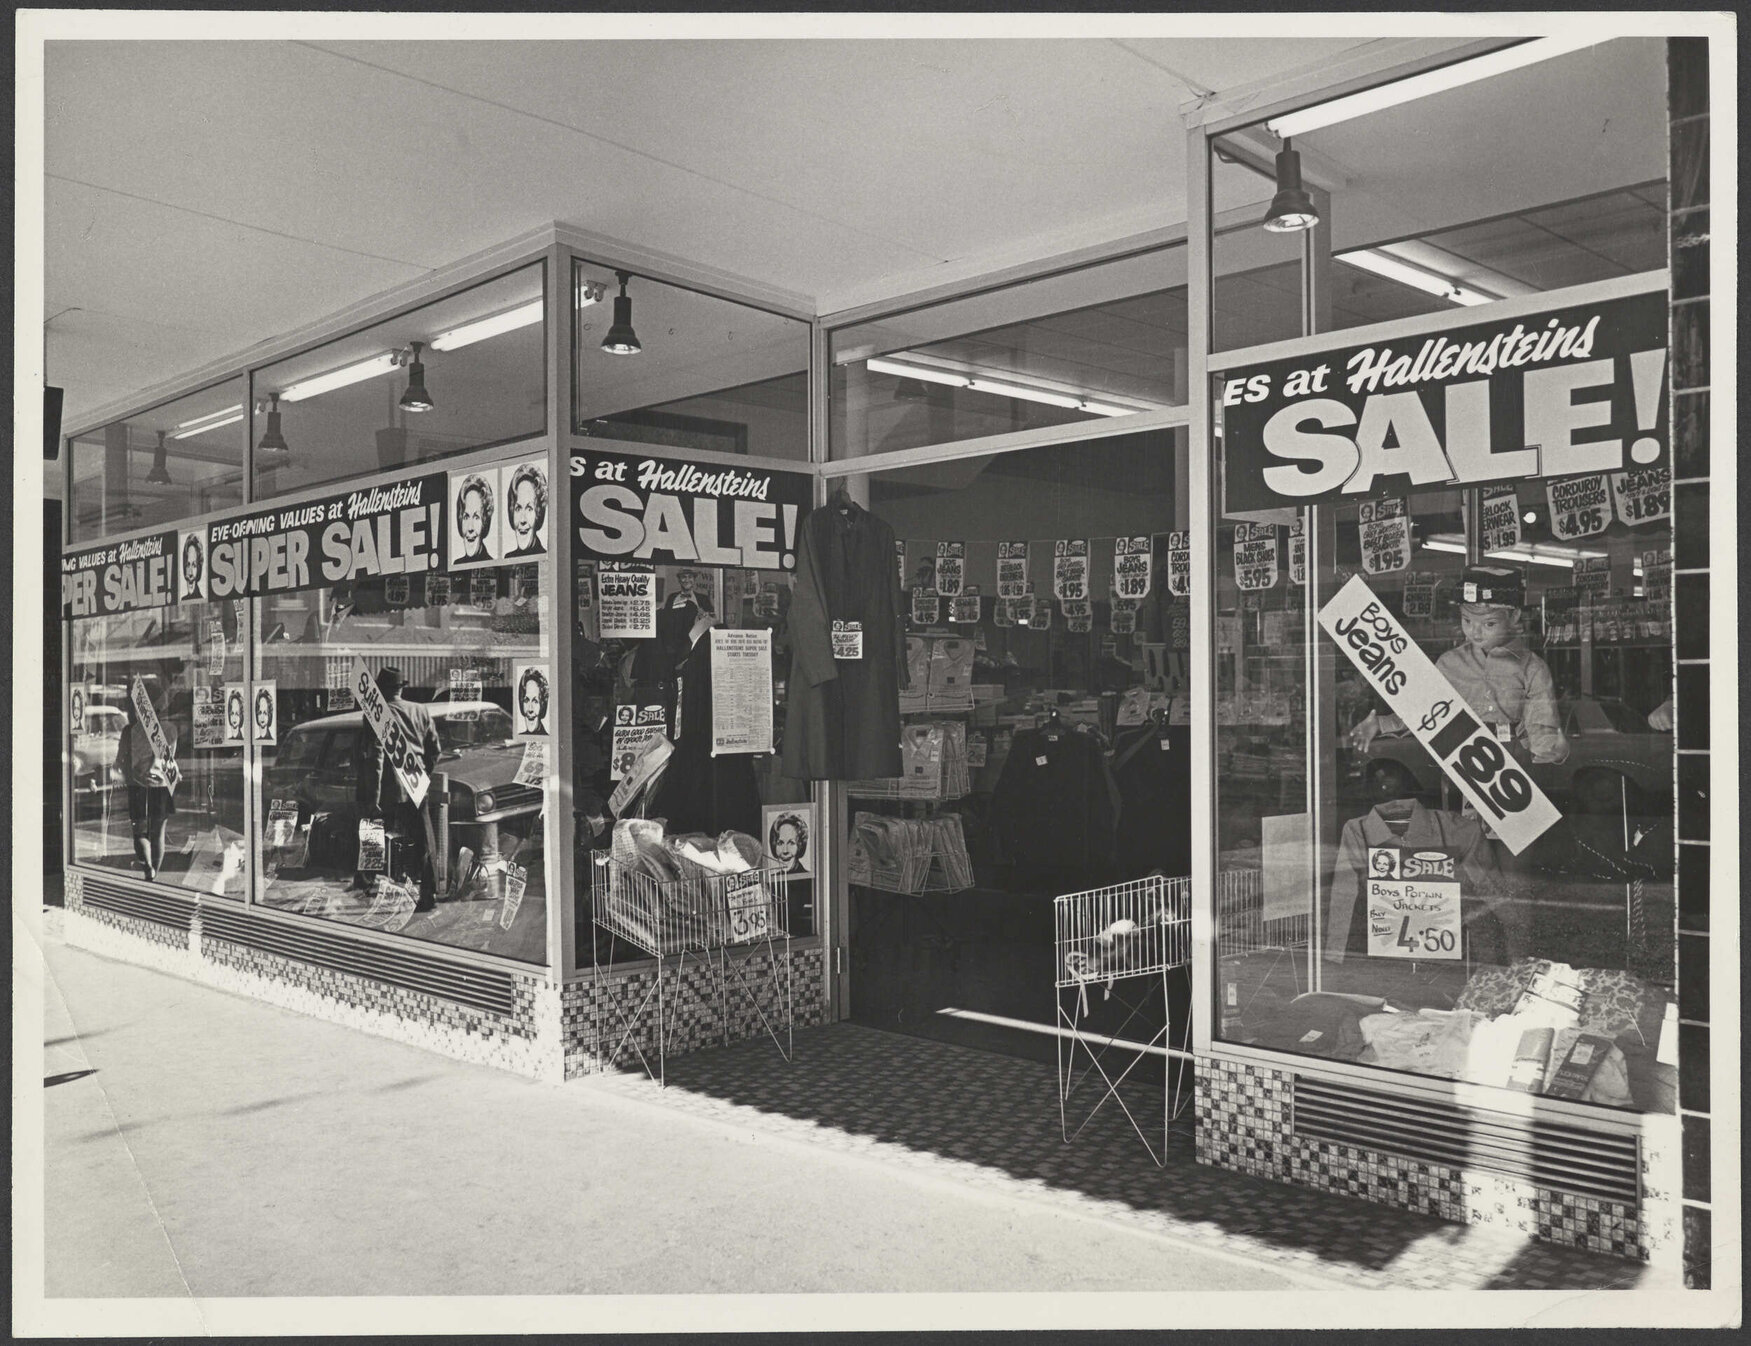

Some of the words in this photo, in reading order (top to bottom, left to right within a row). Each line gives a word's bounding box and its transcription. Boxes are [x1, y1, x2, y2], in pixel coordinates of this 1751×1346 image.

[1283, 364, 1331, 397] at
[1346, 315, 1601, 394] Hallensteins
[1262, 347, 1667, 497] SALE!
[570, 456, 586, 476] S
[595, 461, 628, 481] at
[638, 459, 770, 500] Hallensteins
[1552, 476, 1603, 500] CORDUROY
[1616, 468, 1671, 494] JEANS
[280, 505, 324, 529] VALUES
[328, 501, 343, 519] at
[347, 481, 421, 520] Hallensteins
[1377, 500, 1405, 519] SALE
[1552, 490, 1606, 515] TROUSERS
[1625, 490, 1670, 520] $1.89
[579, 484, 798, 570] SALE!
[1250, 525, 1274, 540] SALE
[1559, 508, 1603, 537] $4.95
[79, 551, 106, 569] VALUES
[107, 548, 117, 563] at
[118, 536, 163, 564] Hallensteins
[210, 528, 309, 597] SUPER
[321, 502, 441, 581] SALE!
[1129, 541, 1149, 554] SALE
[1235, 552, 1255, 566] BLACK
[1243, 542, 1266, 552] MENS
[937, 565, 961, 574] JEANS
[1117, 562, 1148, 574] JEANS
[1124, 556, 1141, 565] BOYS
[1369, 549, 1404, 573] $1.95
[104, 553, 173, 611] SALE!
[601, 584, 648, 597] JEANS
[631, 574, 650, 586] Quality
[1360, 602, 1408, 655] Boys
[1335, 617, 1407, 696] Jeans
[358, 671, 384, 723] Suits
[637, 707, 666, 724] SALE
[1402, 858, 1455, 879] SALE
